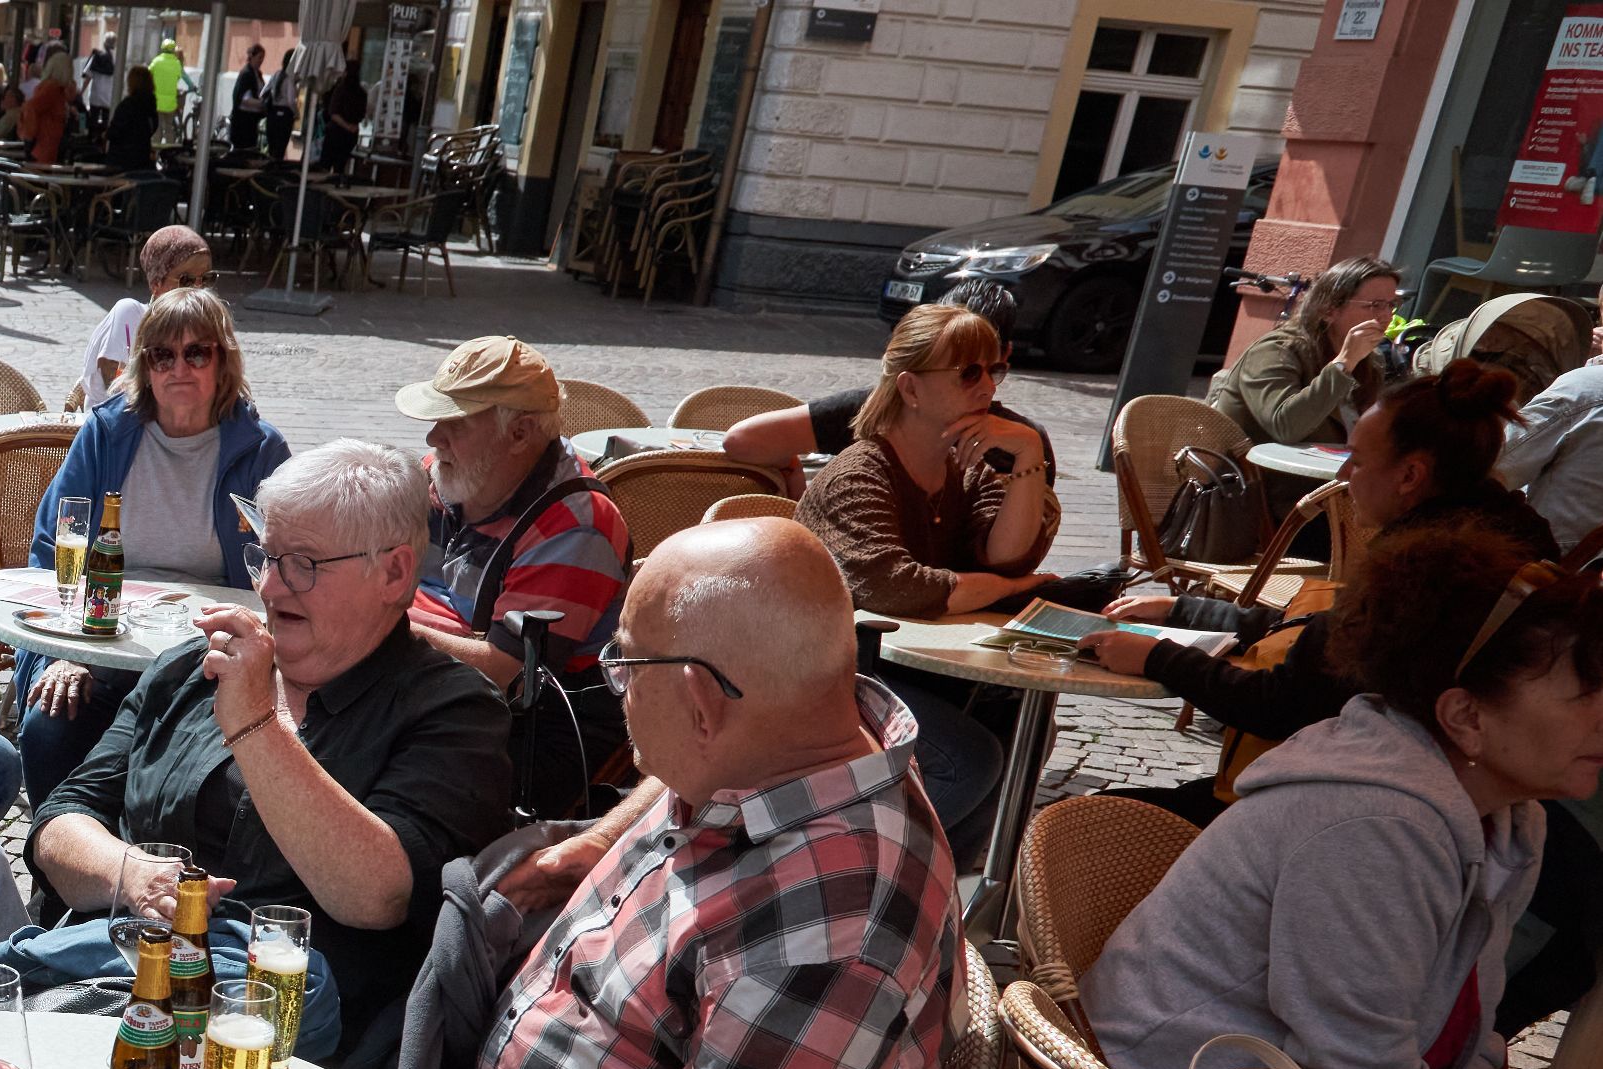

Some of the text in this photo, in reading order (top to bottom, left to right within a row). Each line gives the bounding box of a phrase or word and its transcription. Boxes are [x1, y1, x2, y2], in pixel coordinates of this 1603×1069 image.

[392, 4, 418, 20] PUR
[1352, 10, 1367, 25] 22
[1558, 42, 1582, 58] INS
